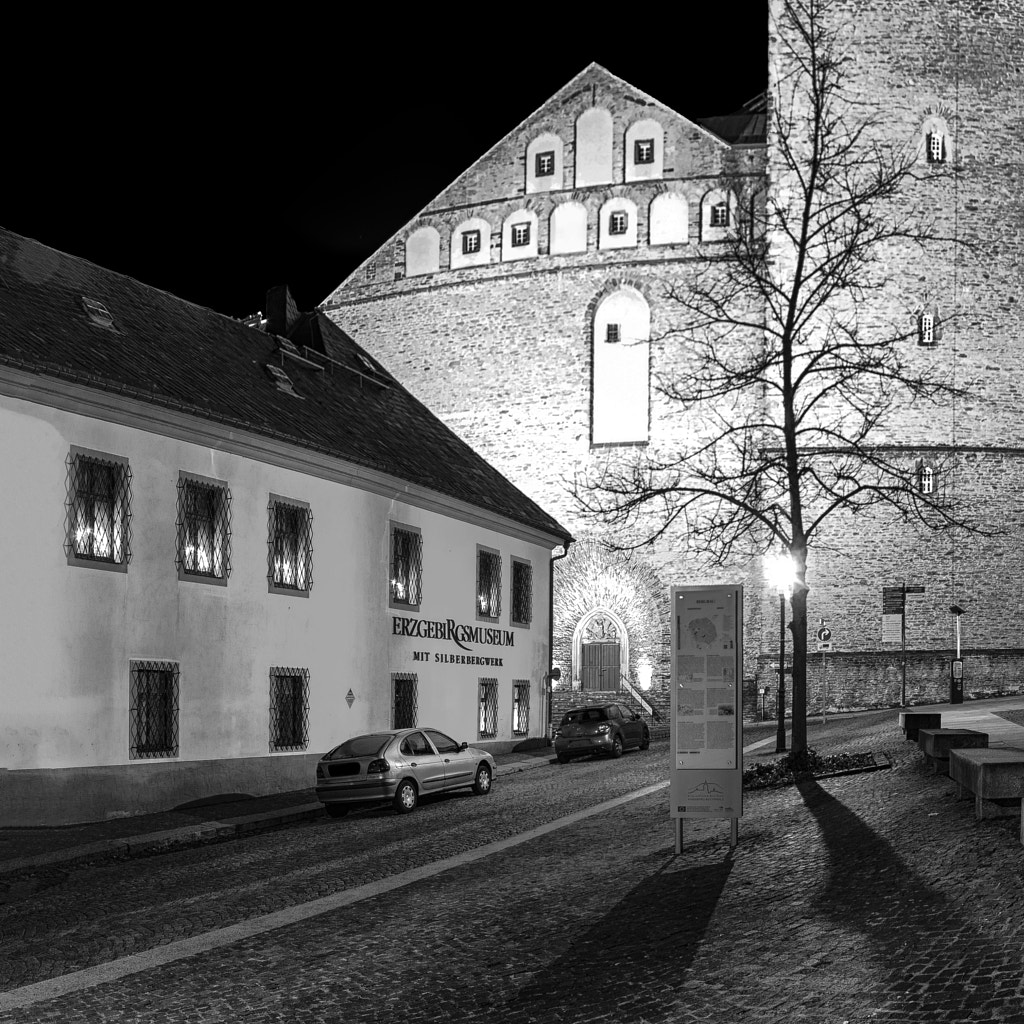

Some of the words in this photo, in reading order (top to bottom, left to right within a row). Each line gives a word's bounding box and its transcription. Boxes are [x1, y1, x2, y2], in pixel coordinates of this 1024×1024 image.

[392, 617, 514, 651] ERZGEBIRGSMUSEUM
[413, 651, 430, 661] MIT
[435, 653, 503, 666] SILBERBERGWERK
